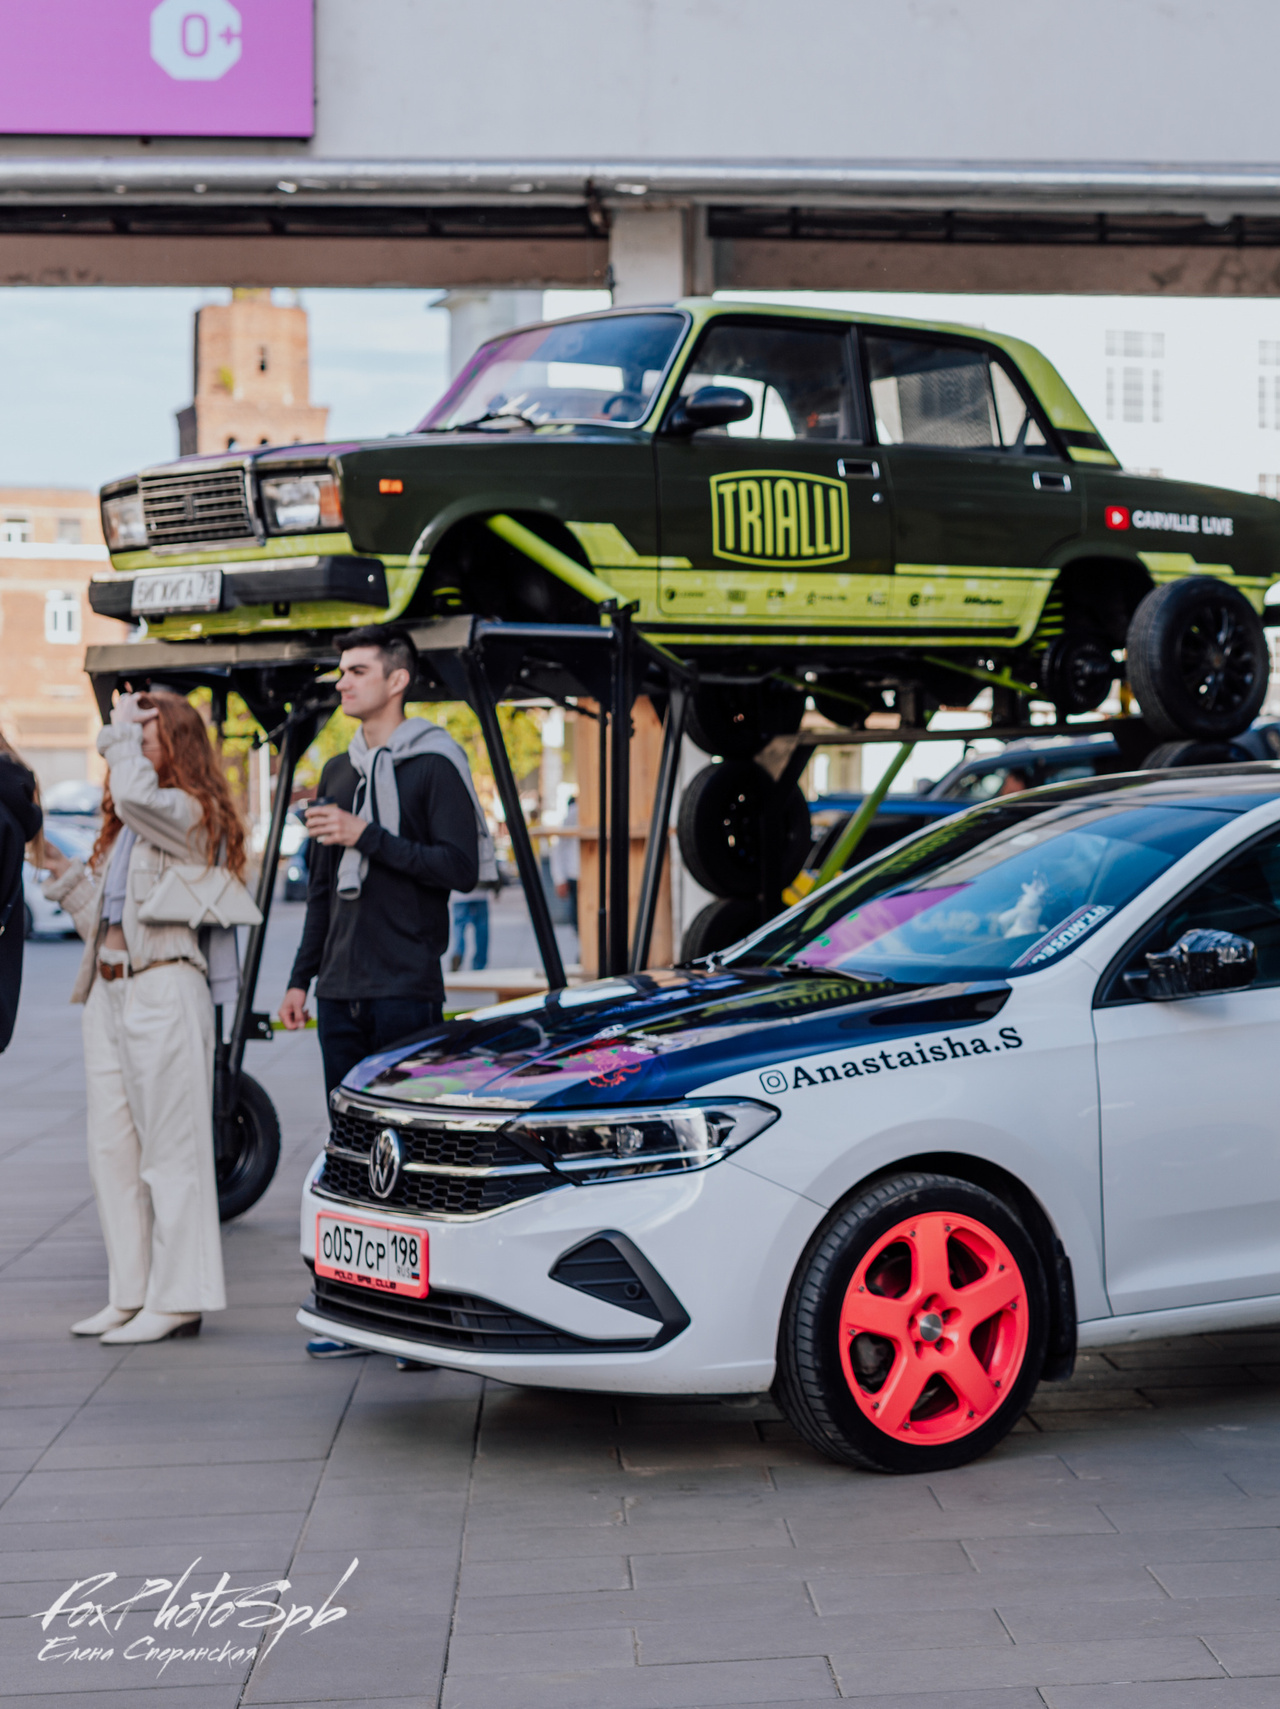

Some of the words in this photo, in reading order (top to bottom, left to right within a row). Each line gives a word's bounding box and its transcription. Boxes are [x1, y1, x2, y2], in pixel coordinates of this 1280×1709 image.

[181, 13, 241, 57] 0+
[717, 478, 840, 557] TRIALLI
[1131, 509, 1200, 534] CARVILLE
[1201, 516, 1234, 537] LIVE
[792, 1026, 1023, 1089] Anastaisha.S
[391, 1235, 418, 1267] 198
[396, 1264, 411, 1279] RUS
